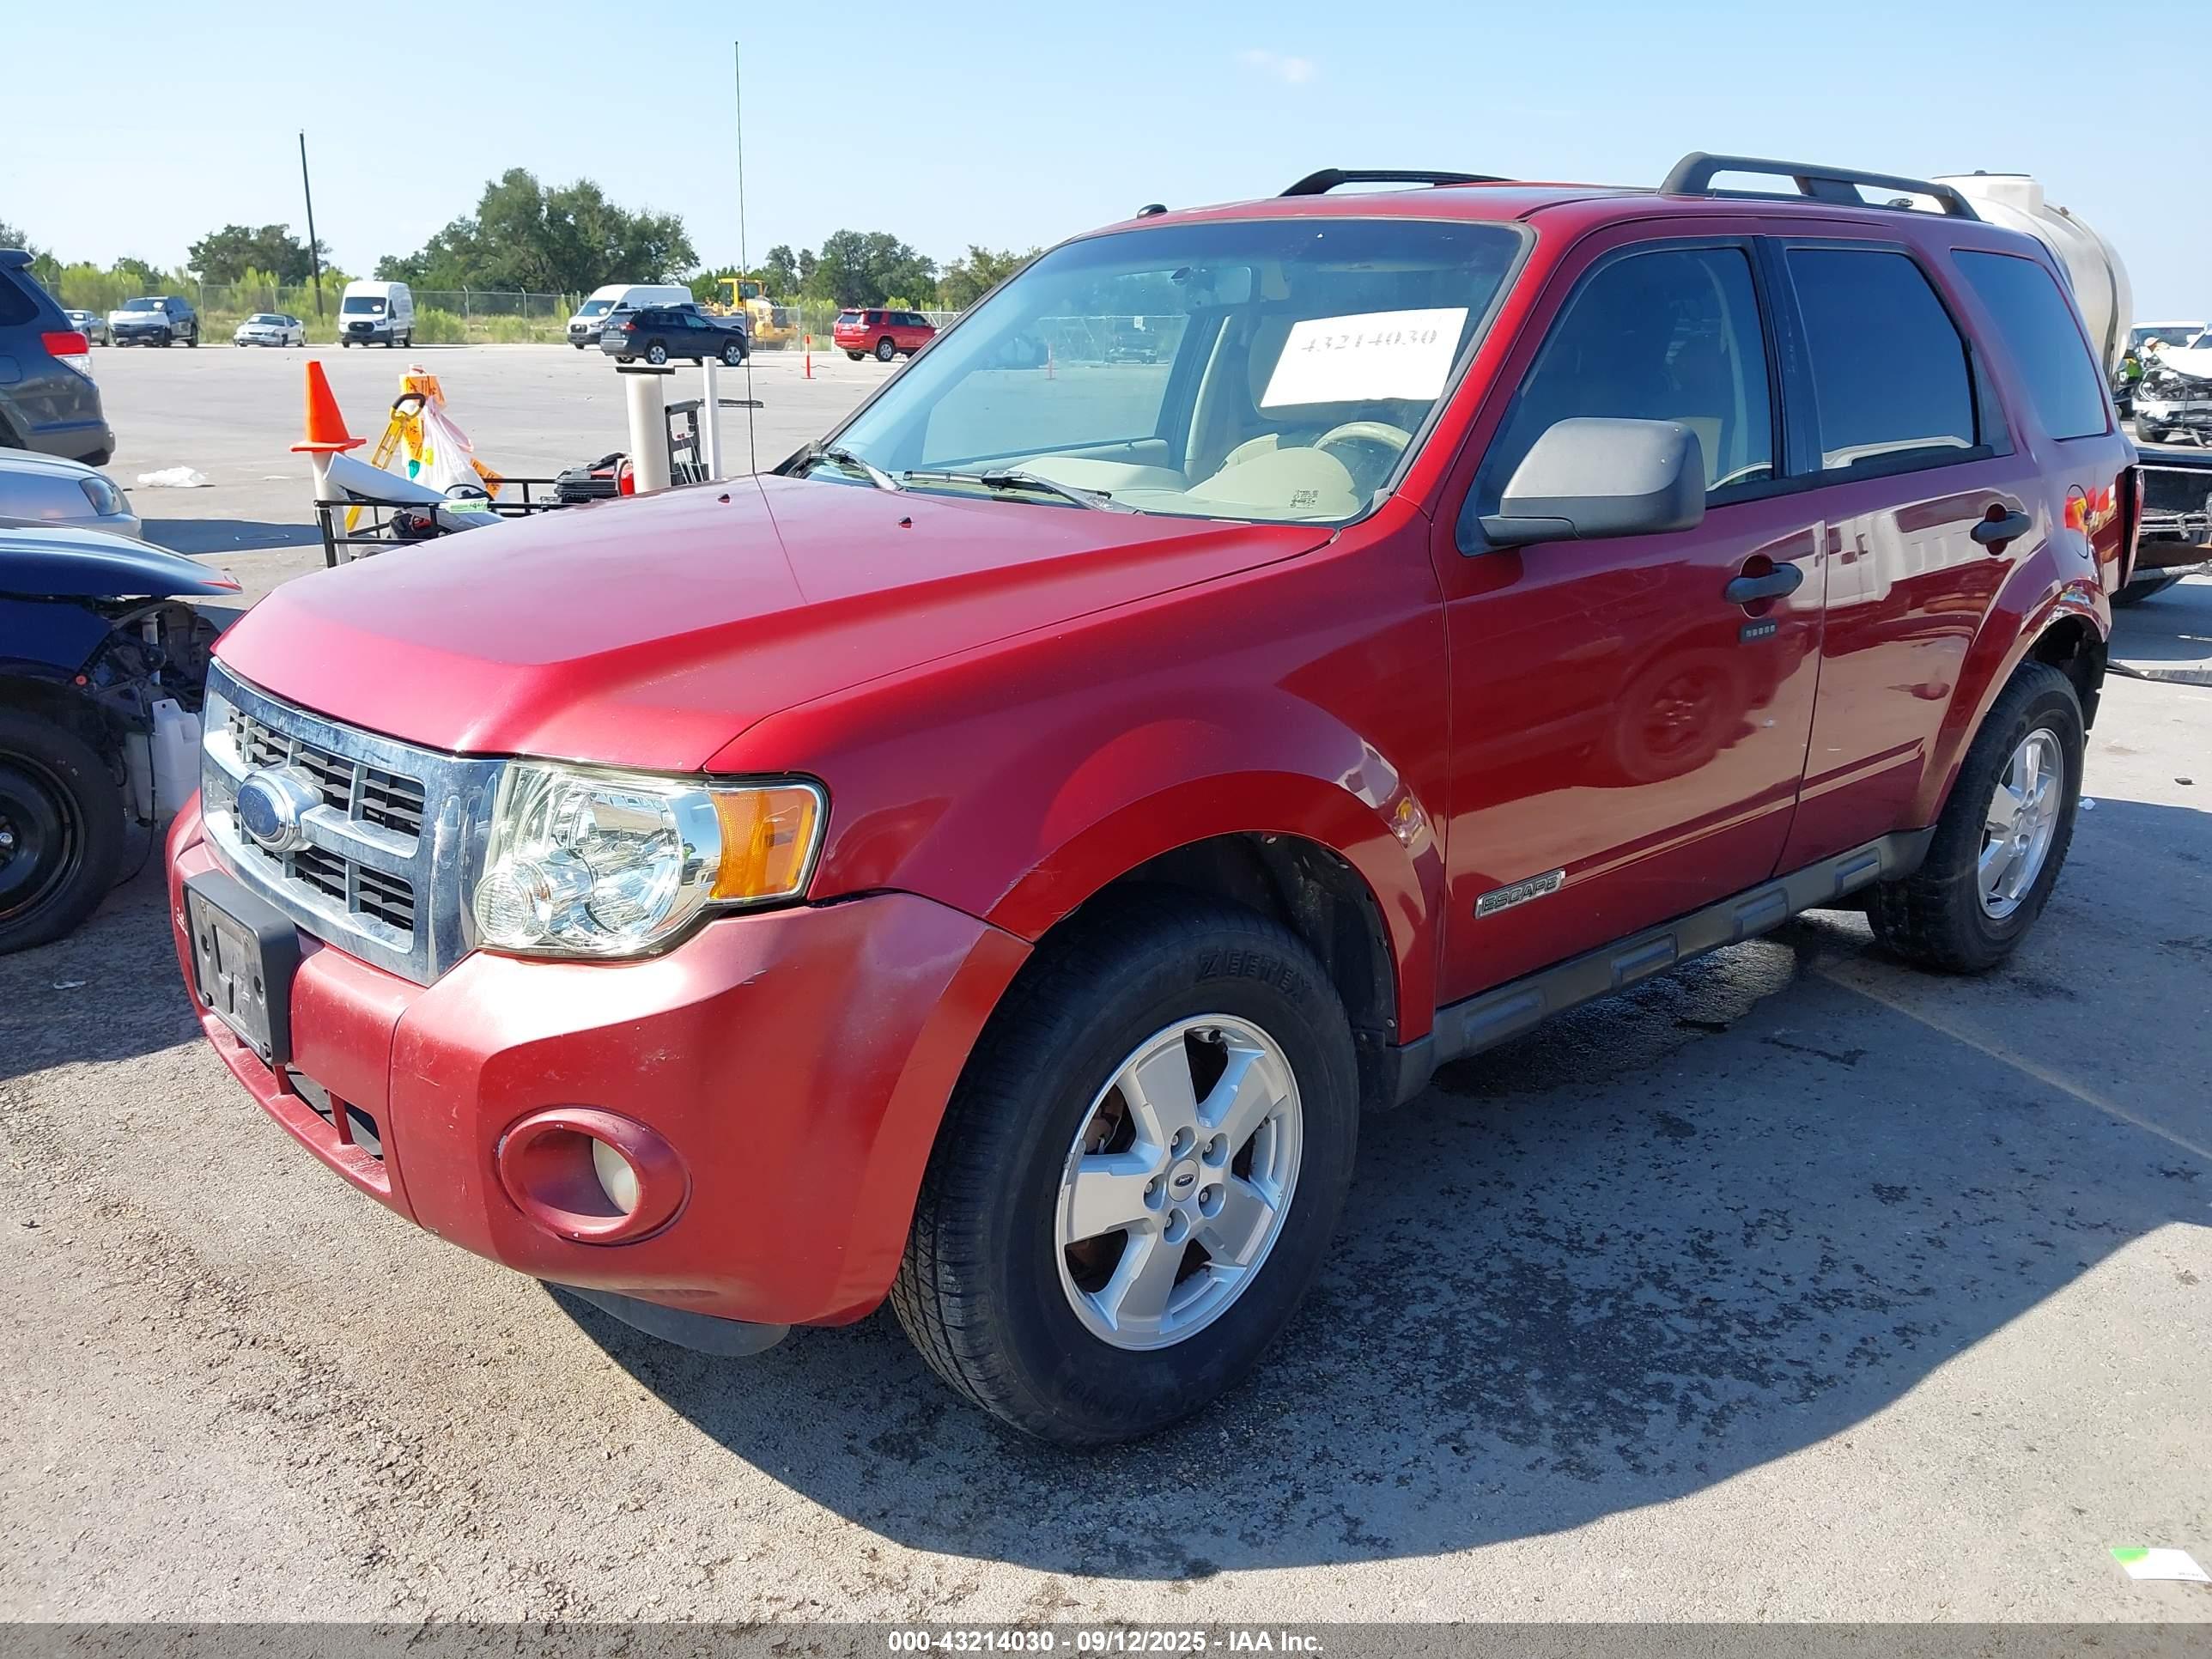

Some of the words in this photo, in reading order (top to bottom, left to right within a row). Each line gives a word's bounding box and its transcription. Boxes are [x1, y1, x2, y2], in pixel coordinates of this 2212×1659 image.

[1300, 329, 1438, 353] 43214030
[1482, 875, 1559, 912] ESCAPE
[1197, 951, 1312, 1003] ZEETEX
